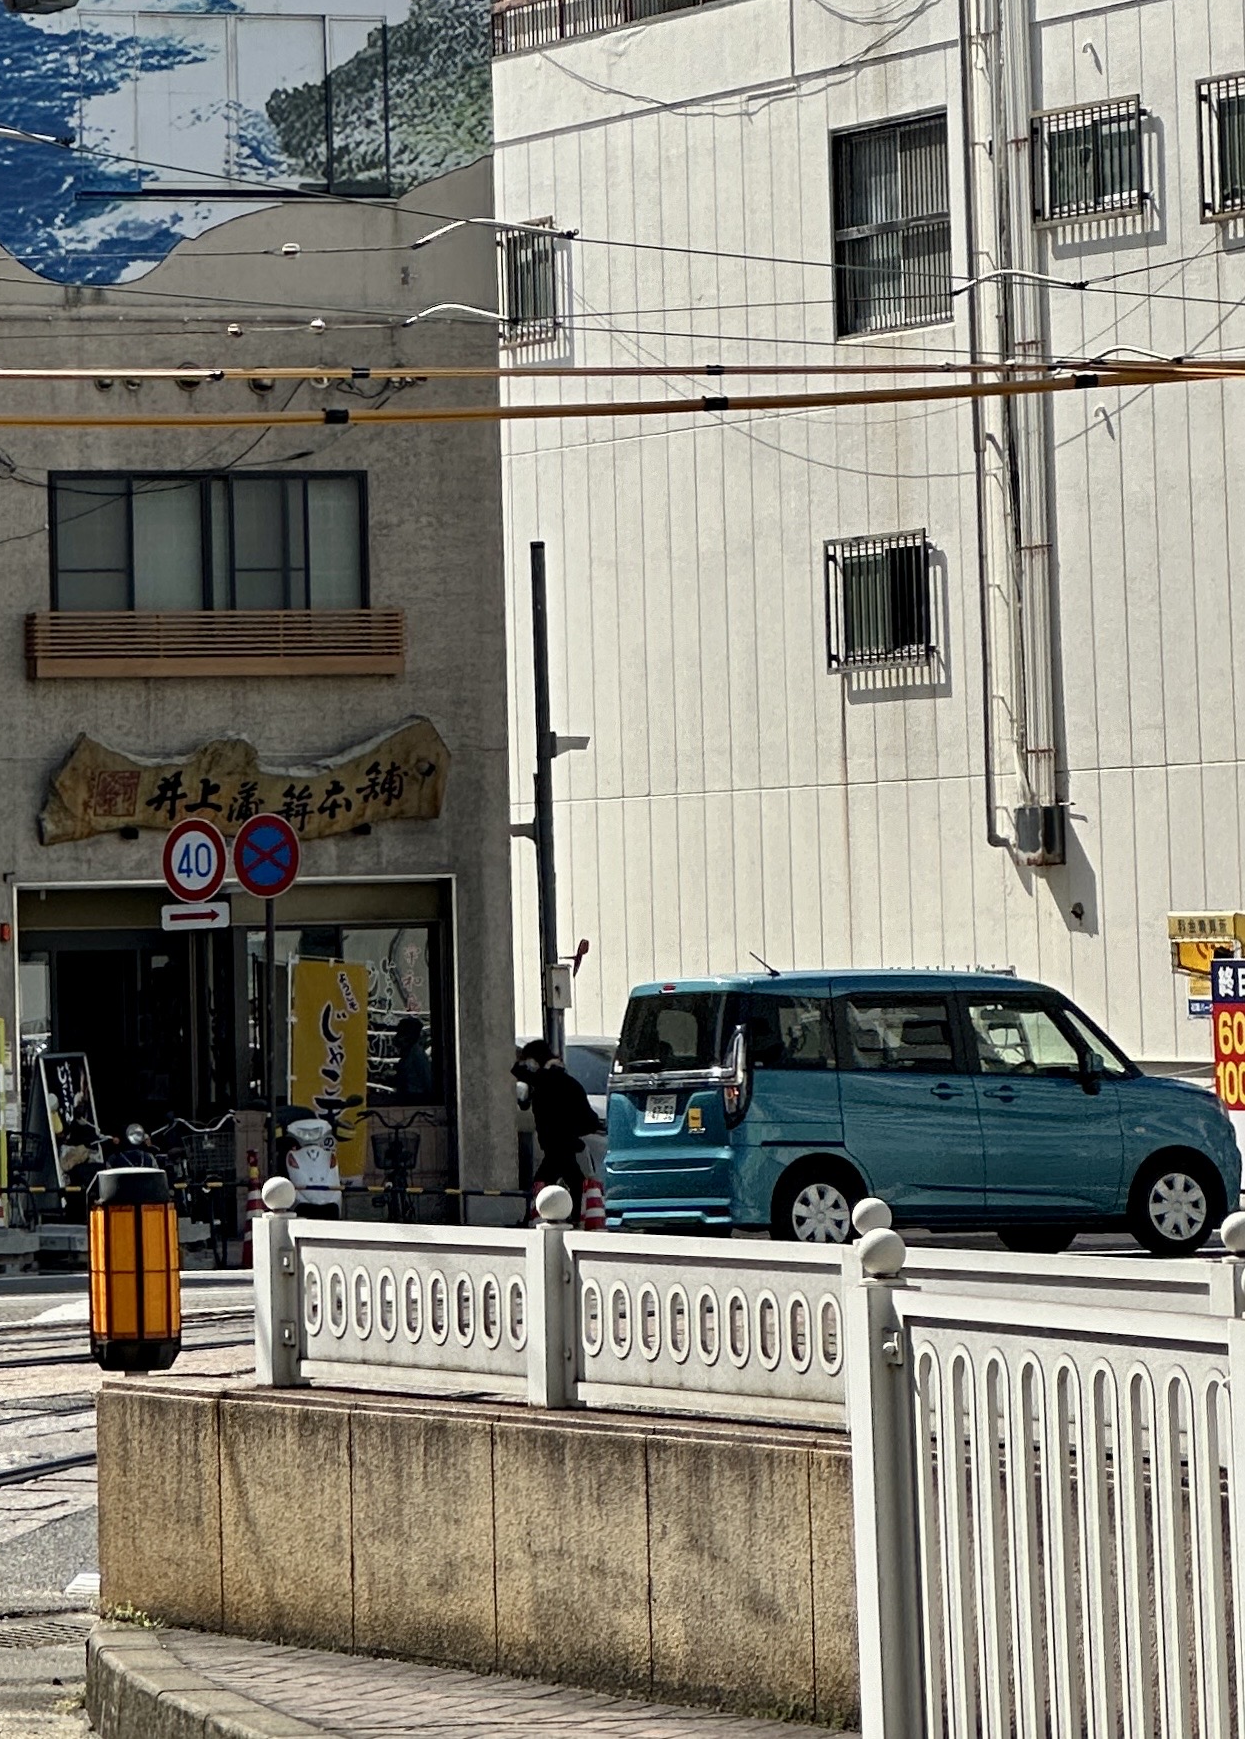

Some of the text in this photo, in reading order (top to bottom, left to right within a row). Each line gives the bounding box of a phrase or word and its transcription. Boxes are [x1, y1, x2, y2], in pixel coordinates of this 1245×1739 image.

[144, 760, 408, 833] 井上蒲鉾本舗
[177, 842, 213, 879] 40
